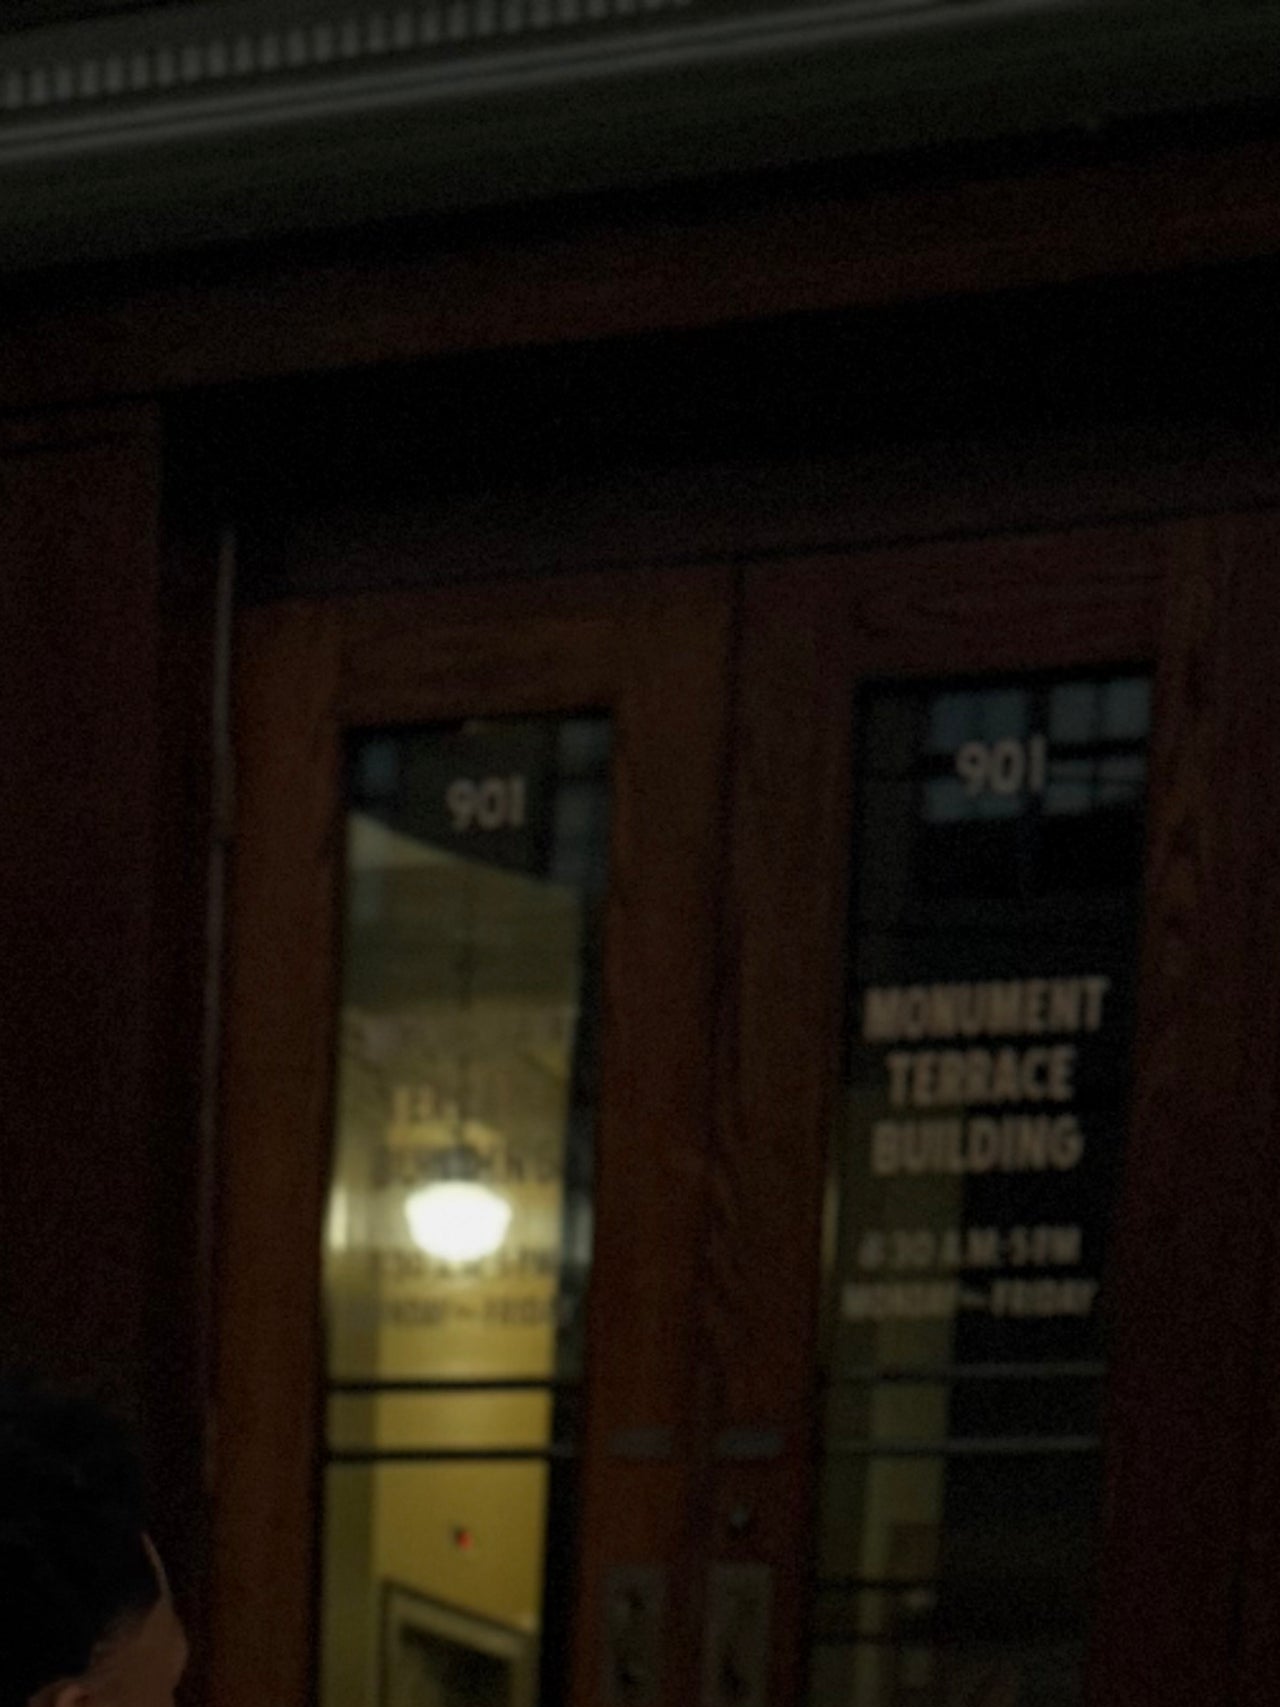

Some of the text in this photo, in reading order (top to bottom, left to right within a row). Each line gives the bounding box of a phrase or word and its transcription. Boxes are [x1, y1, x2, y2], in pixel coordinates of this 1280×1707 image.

[956, 735, 1046, 797] 901
[445, 775, 526, 831] 901
[862, 975, 1111, 1042] MONUMENT
[885, 1043, 1078, 1107] TERRACE
[870, 1113, 1086, 1177] BUILDING
